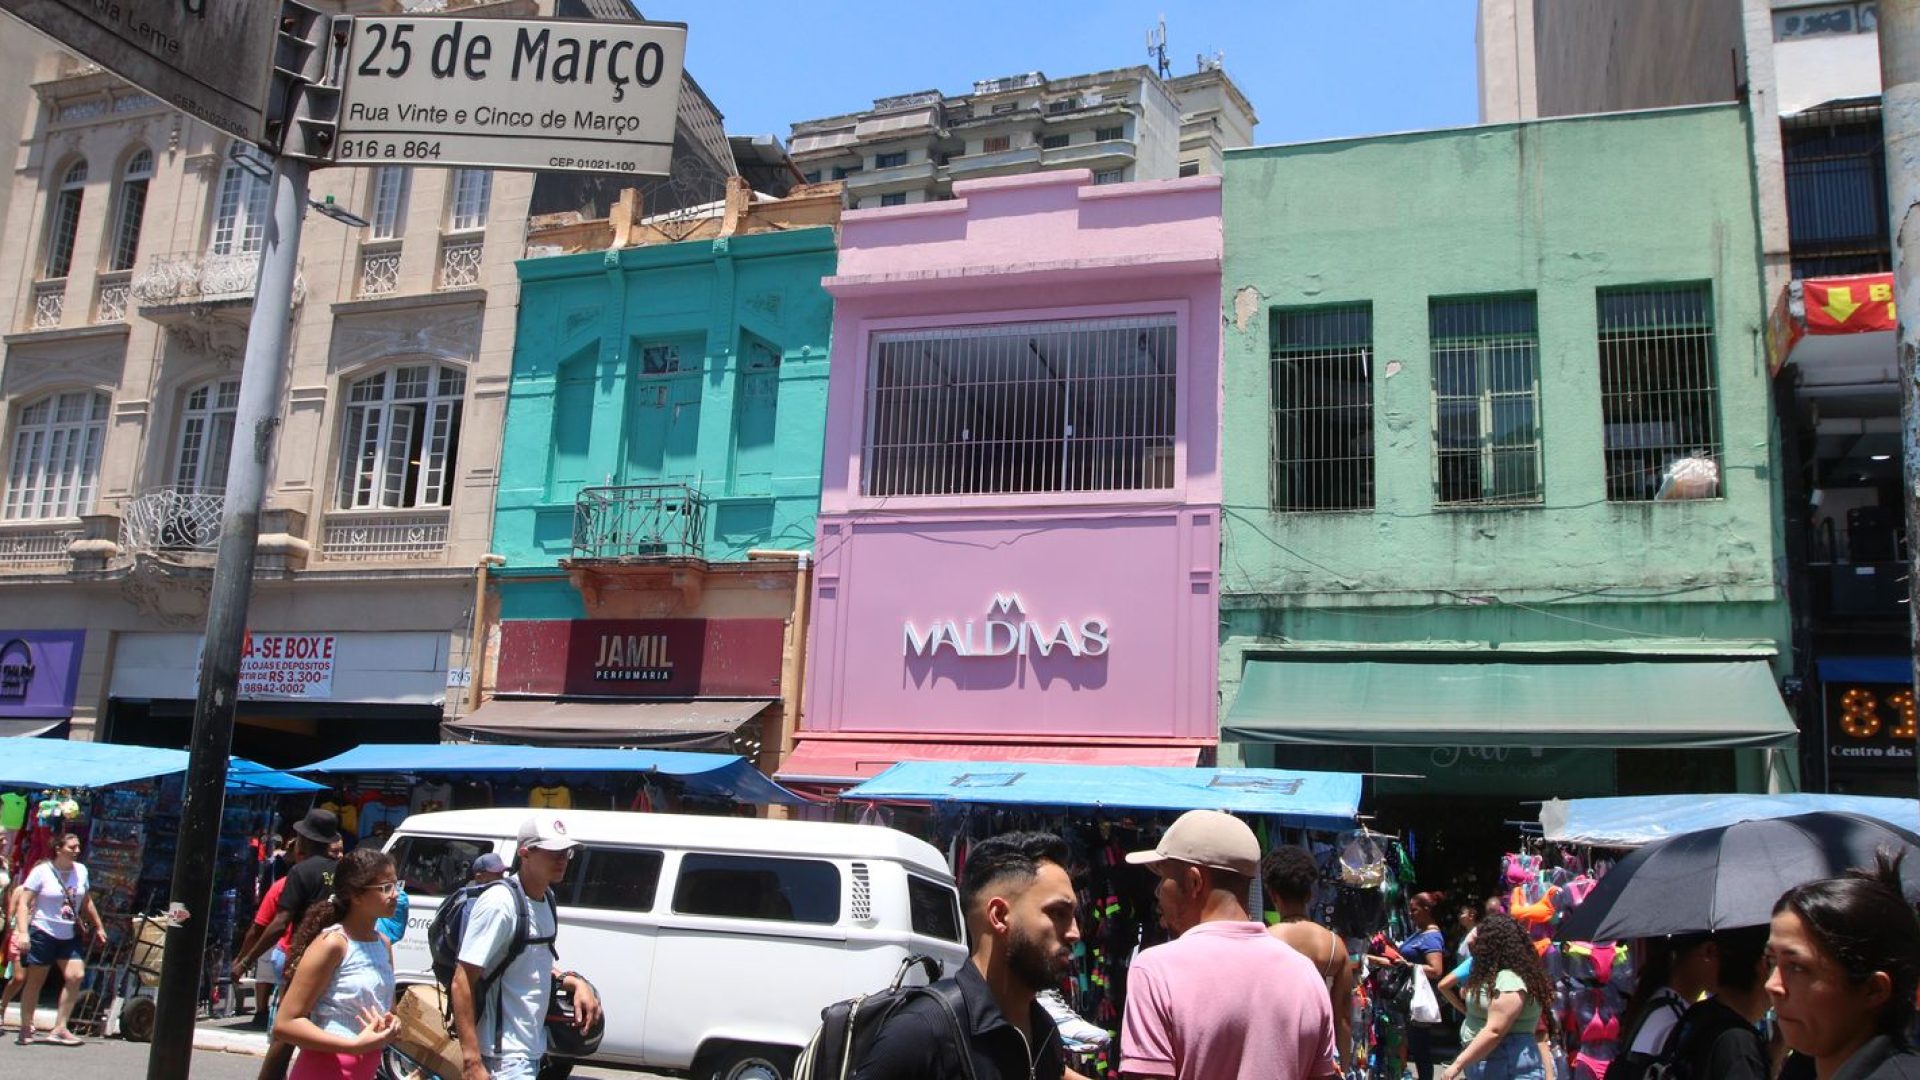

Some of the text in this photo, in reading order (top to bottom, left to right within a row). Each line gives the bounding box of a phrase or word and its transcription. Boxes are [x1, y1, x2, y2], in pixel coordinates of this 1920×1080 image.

[127, 10, 180, 53] Leme
[358, 21, 664, 103] 25 de Março
[349, 103, 640, 136] Rua Vinte e Cinco de Março
[341, 140, 441, 159] 816 a 864
[549, 157, 636, 171] CEP 01021-100
[903, 615, 1110, 657] MALDIVAS
[284, 636, 321, 659] BOX
[322, 636, 335, 659] E
[594, 635, 674, 668] JAMIL
[247, 661, 275, 671] LOJAS
[450, 670, 471, 683] 795
[596, 670, 668, 680] PERFUMARIA
[244, 682, 306, 693] 98942-0002
[1831, 744, 1913, 757] Centro das
[407, 917, 433, 930] orre
